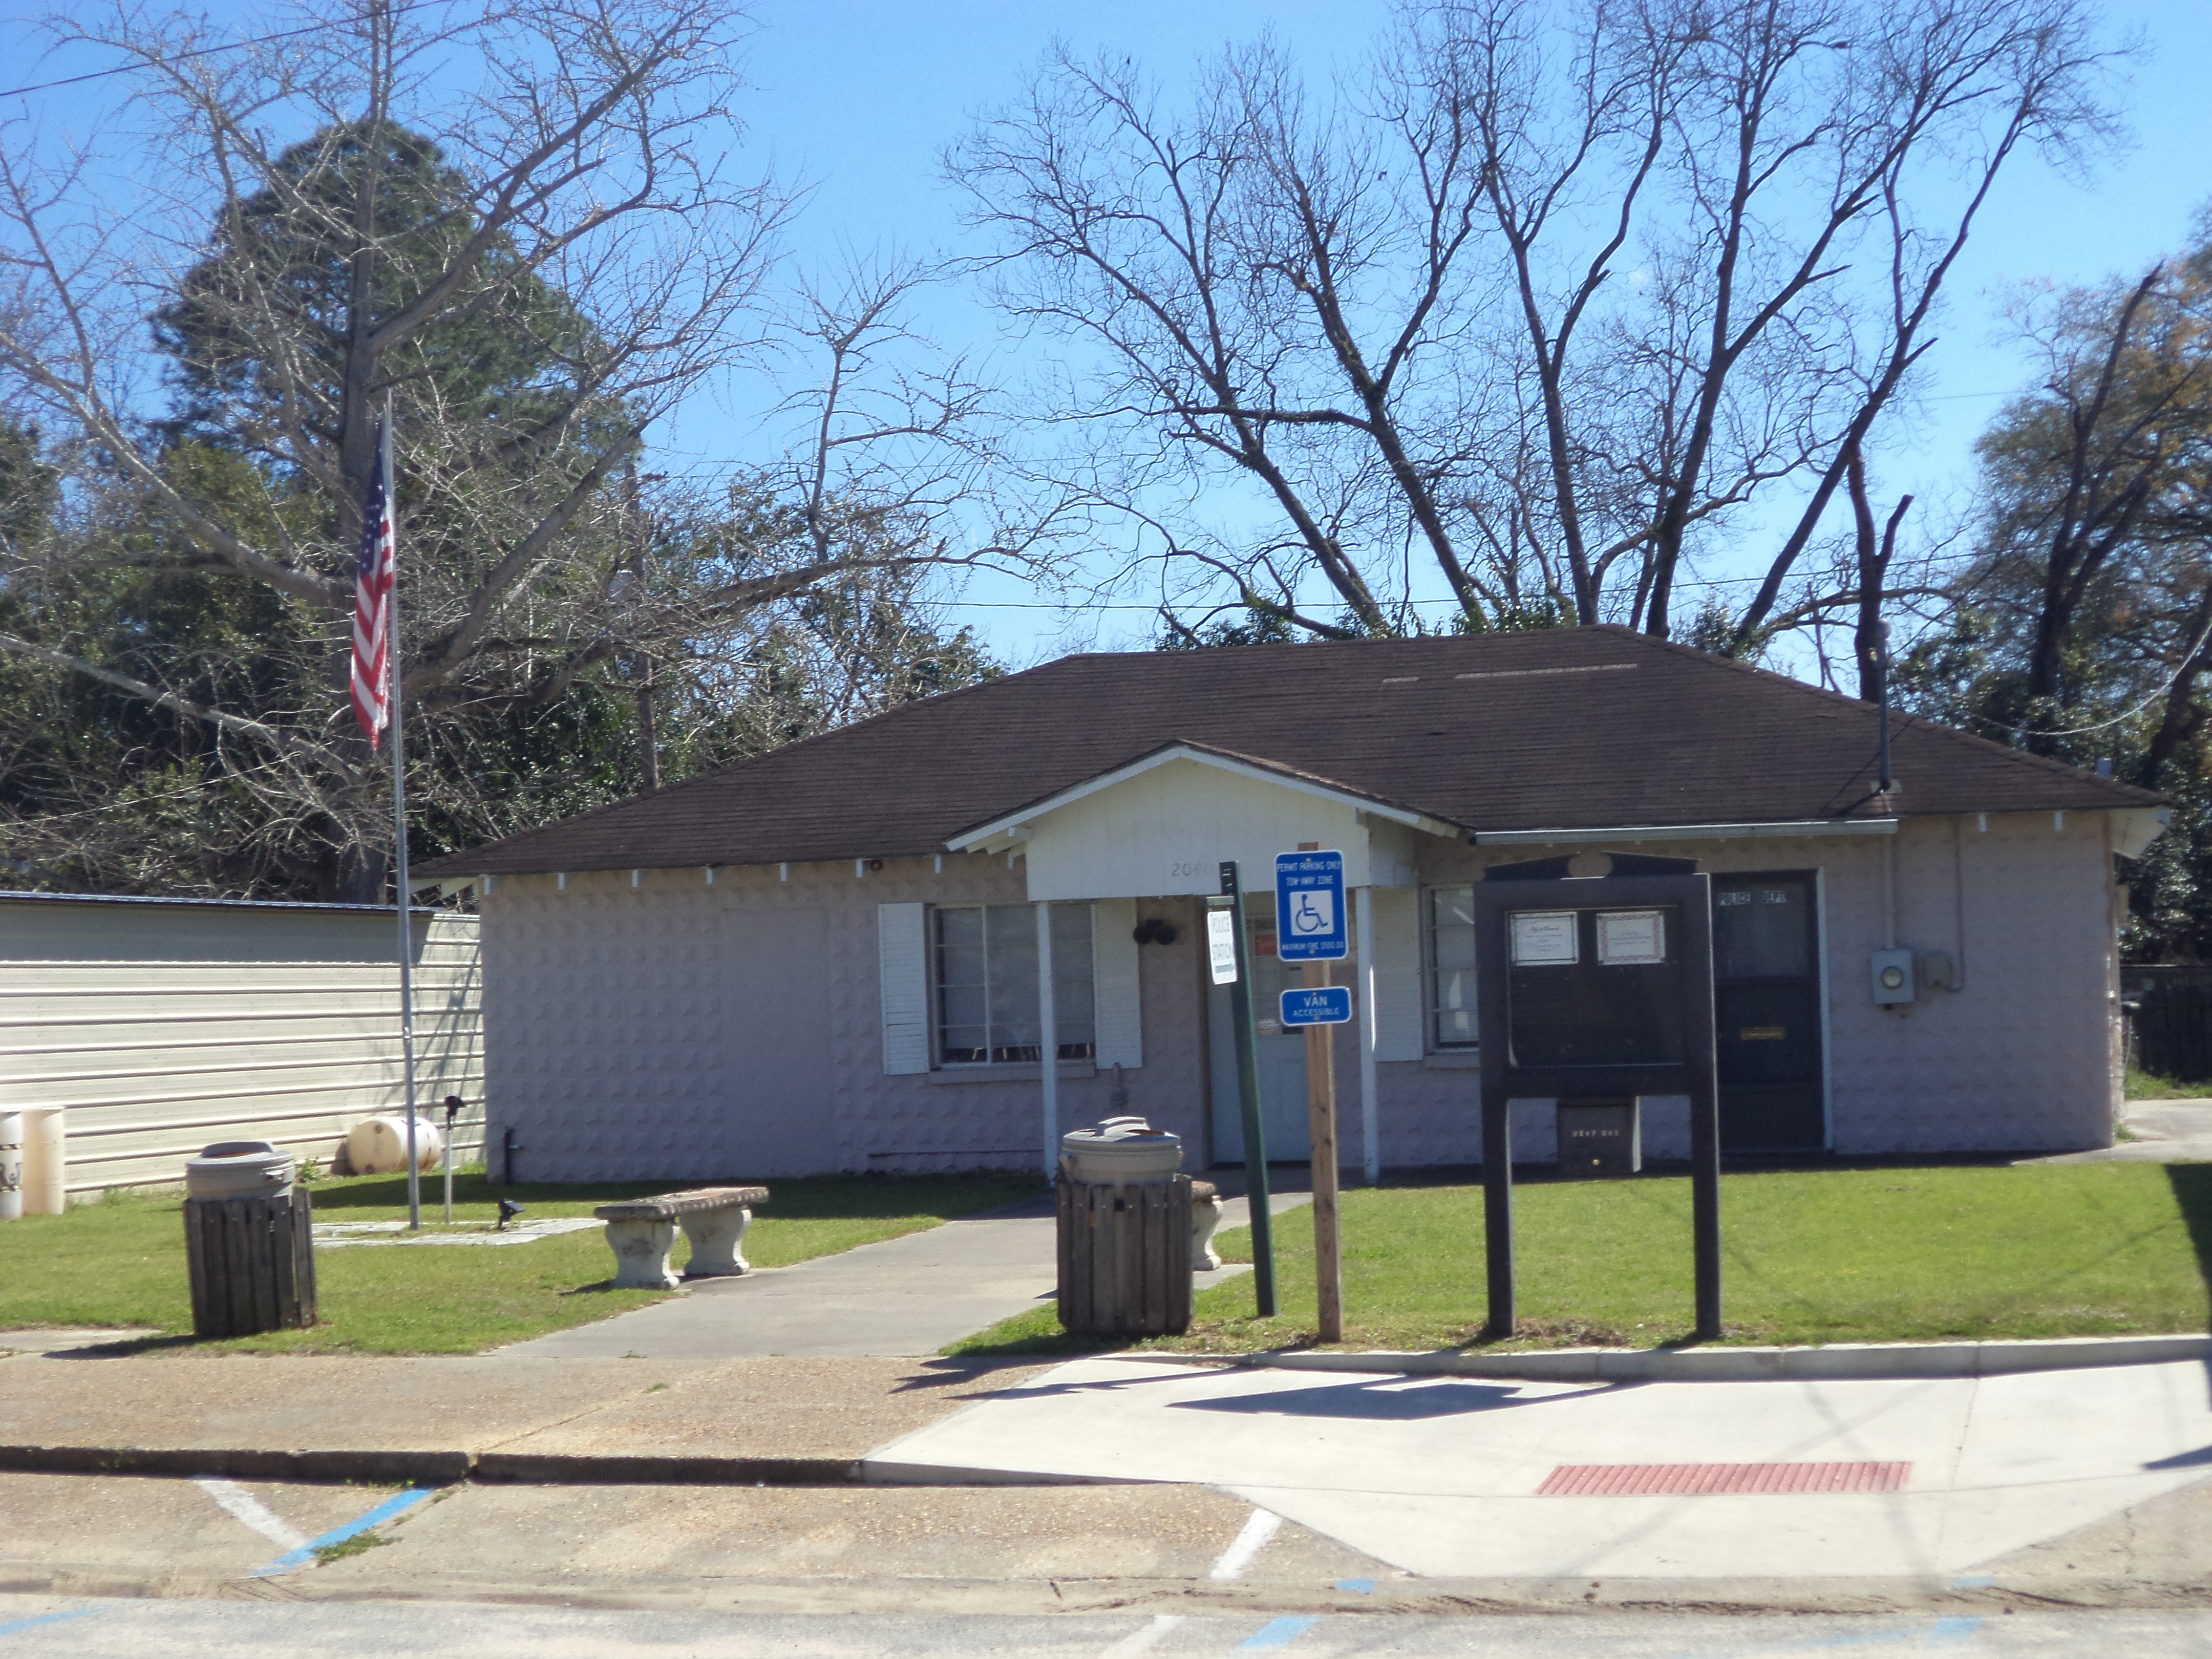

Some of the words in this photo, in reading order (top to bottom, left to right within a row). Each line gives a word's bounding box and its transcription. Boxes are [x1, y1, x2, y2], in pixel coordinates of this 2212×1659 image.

[1278, 863, 1298, 872] PERMIT
[1300, 861, 1324, 870] PARKING
[1326, 861, 1341, 869] ONLY
[1286, 876, 1315, 886] TOW-AWAY
[1317, 875, 1333, 885] ZONE
[1282, 943, 1306, 951] MAXIMUM
[1303, 996, 1328, 1007] VAN
[1293, 1007, 1340, 1017] ACCESSIBLE
